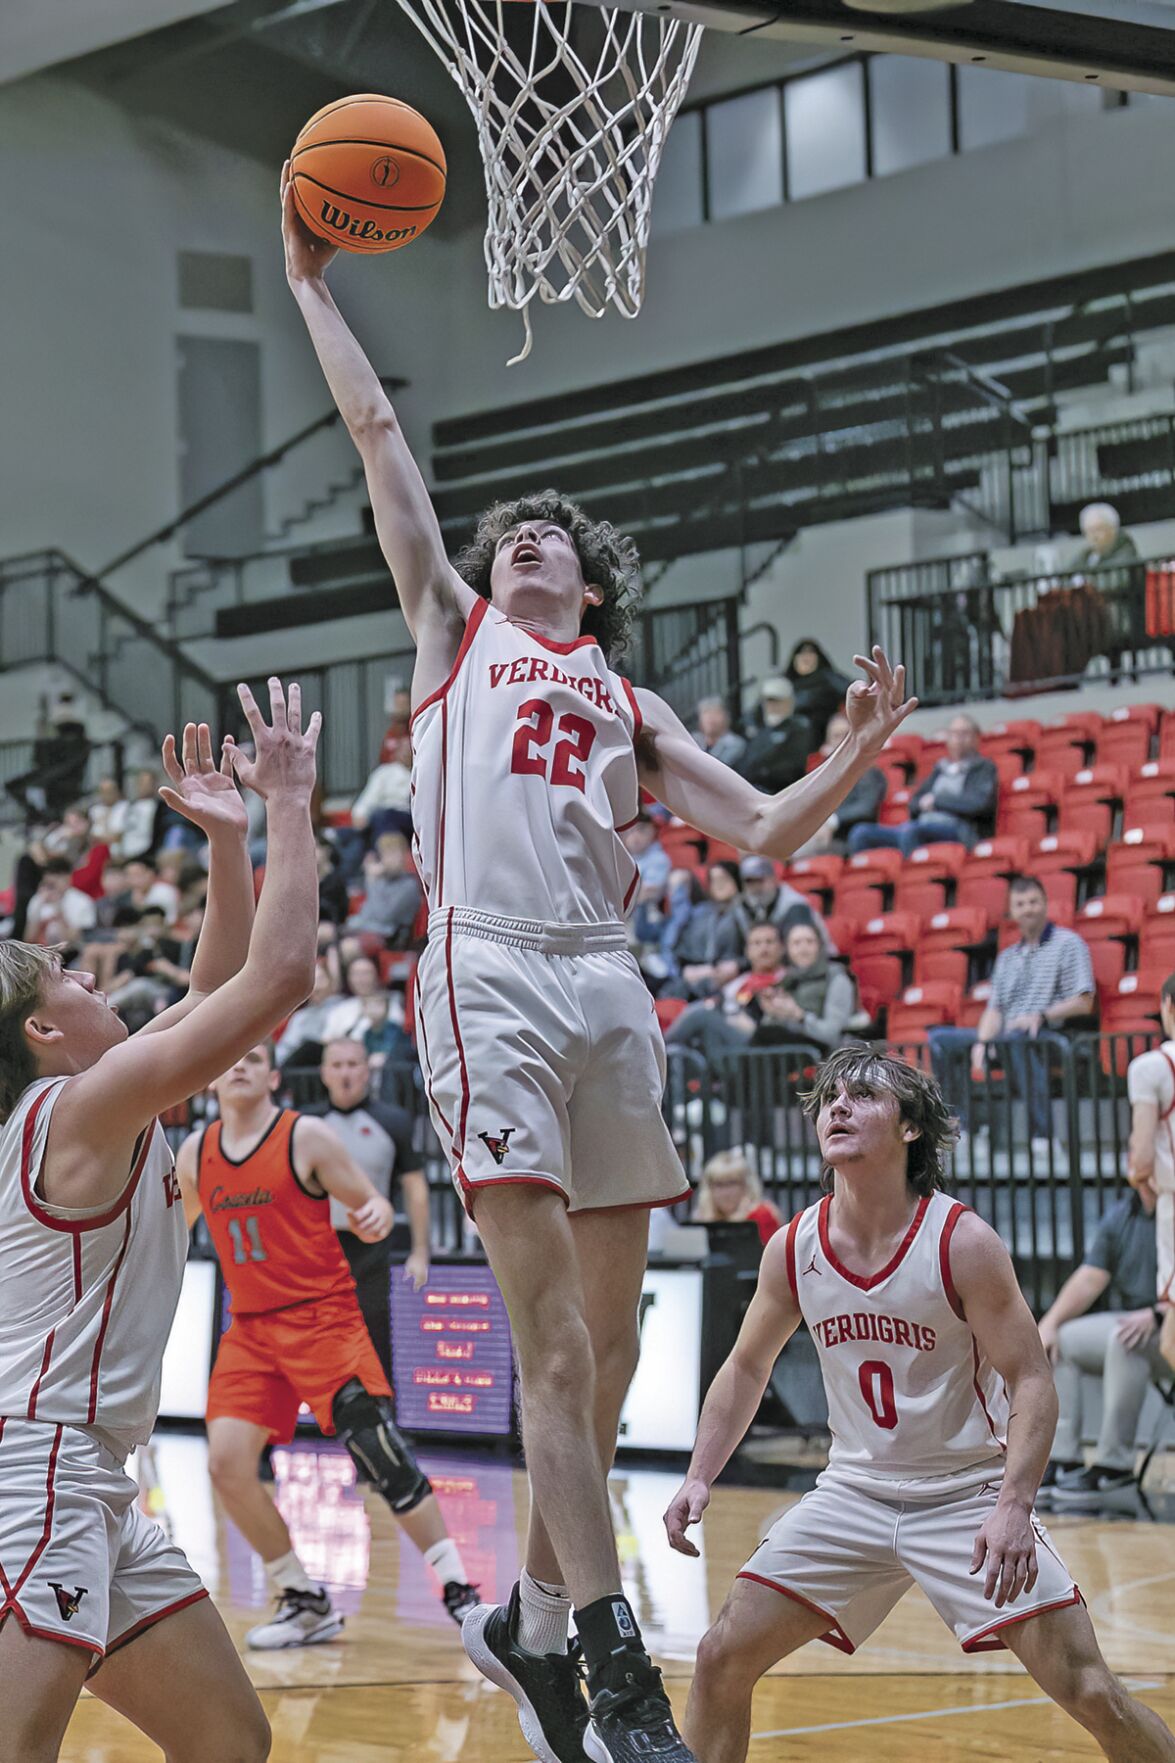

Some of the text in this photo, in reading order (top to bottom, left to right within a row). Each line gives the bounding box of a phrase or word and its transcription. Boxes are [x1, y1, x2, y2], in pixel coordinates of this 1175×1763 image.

[321, 199, 417, 241] Wilson
[489, 657, 622, 719] VERDIGR
[511, 698, 596, 795] 22
[229, 1216, 267, 1264] 11
[813, 1312, 936, 1352] VERDIGRIS
[858, 1360, 898, 1430] 0
